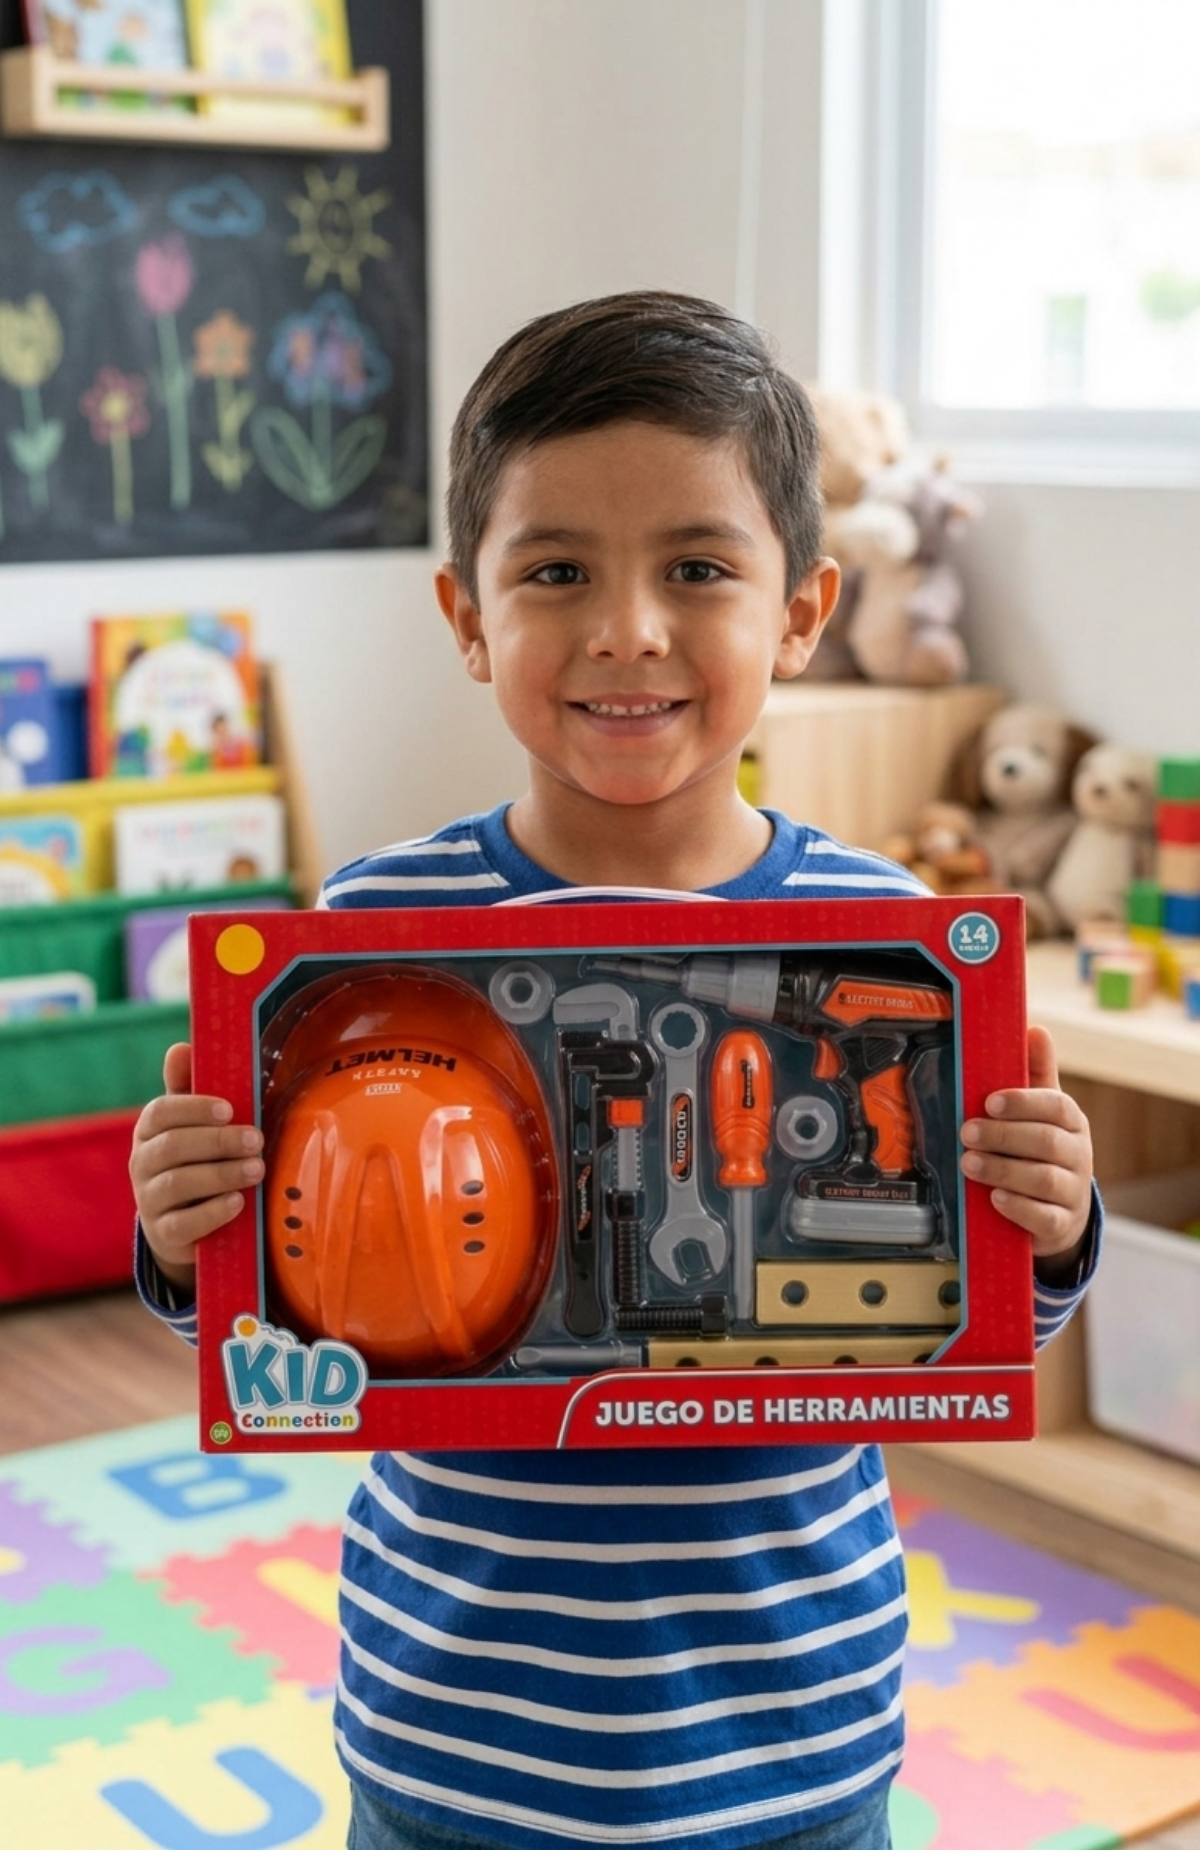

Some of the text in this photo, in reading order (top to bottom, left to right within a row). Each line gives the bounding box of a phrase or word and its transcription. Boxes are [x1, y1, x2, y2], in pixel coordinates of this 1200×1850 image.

[960, 924, 988, 944] 14
[325, 1048, 457, 1077] HELMET
[228, 1341, 361, 1409] KID
[242, 1412, 354, 1428] Connection
[595, 1394, 1010, 1426] JUEGO DE HERRAMIENTAS
